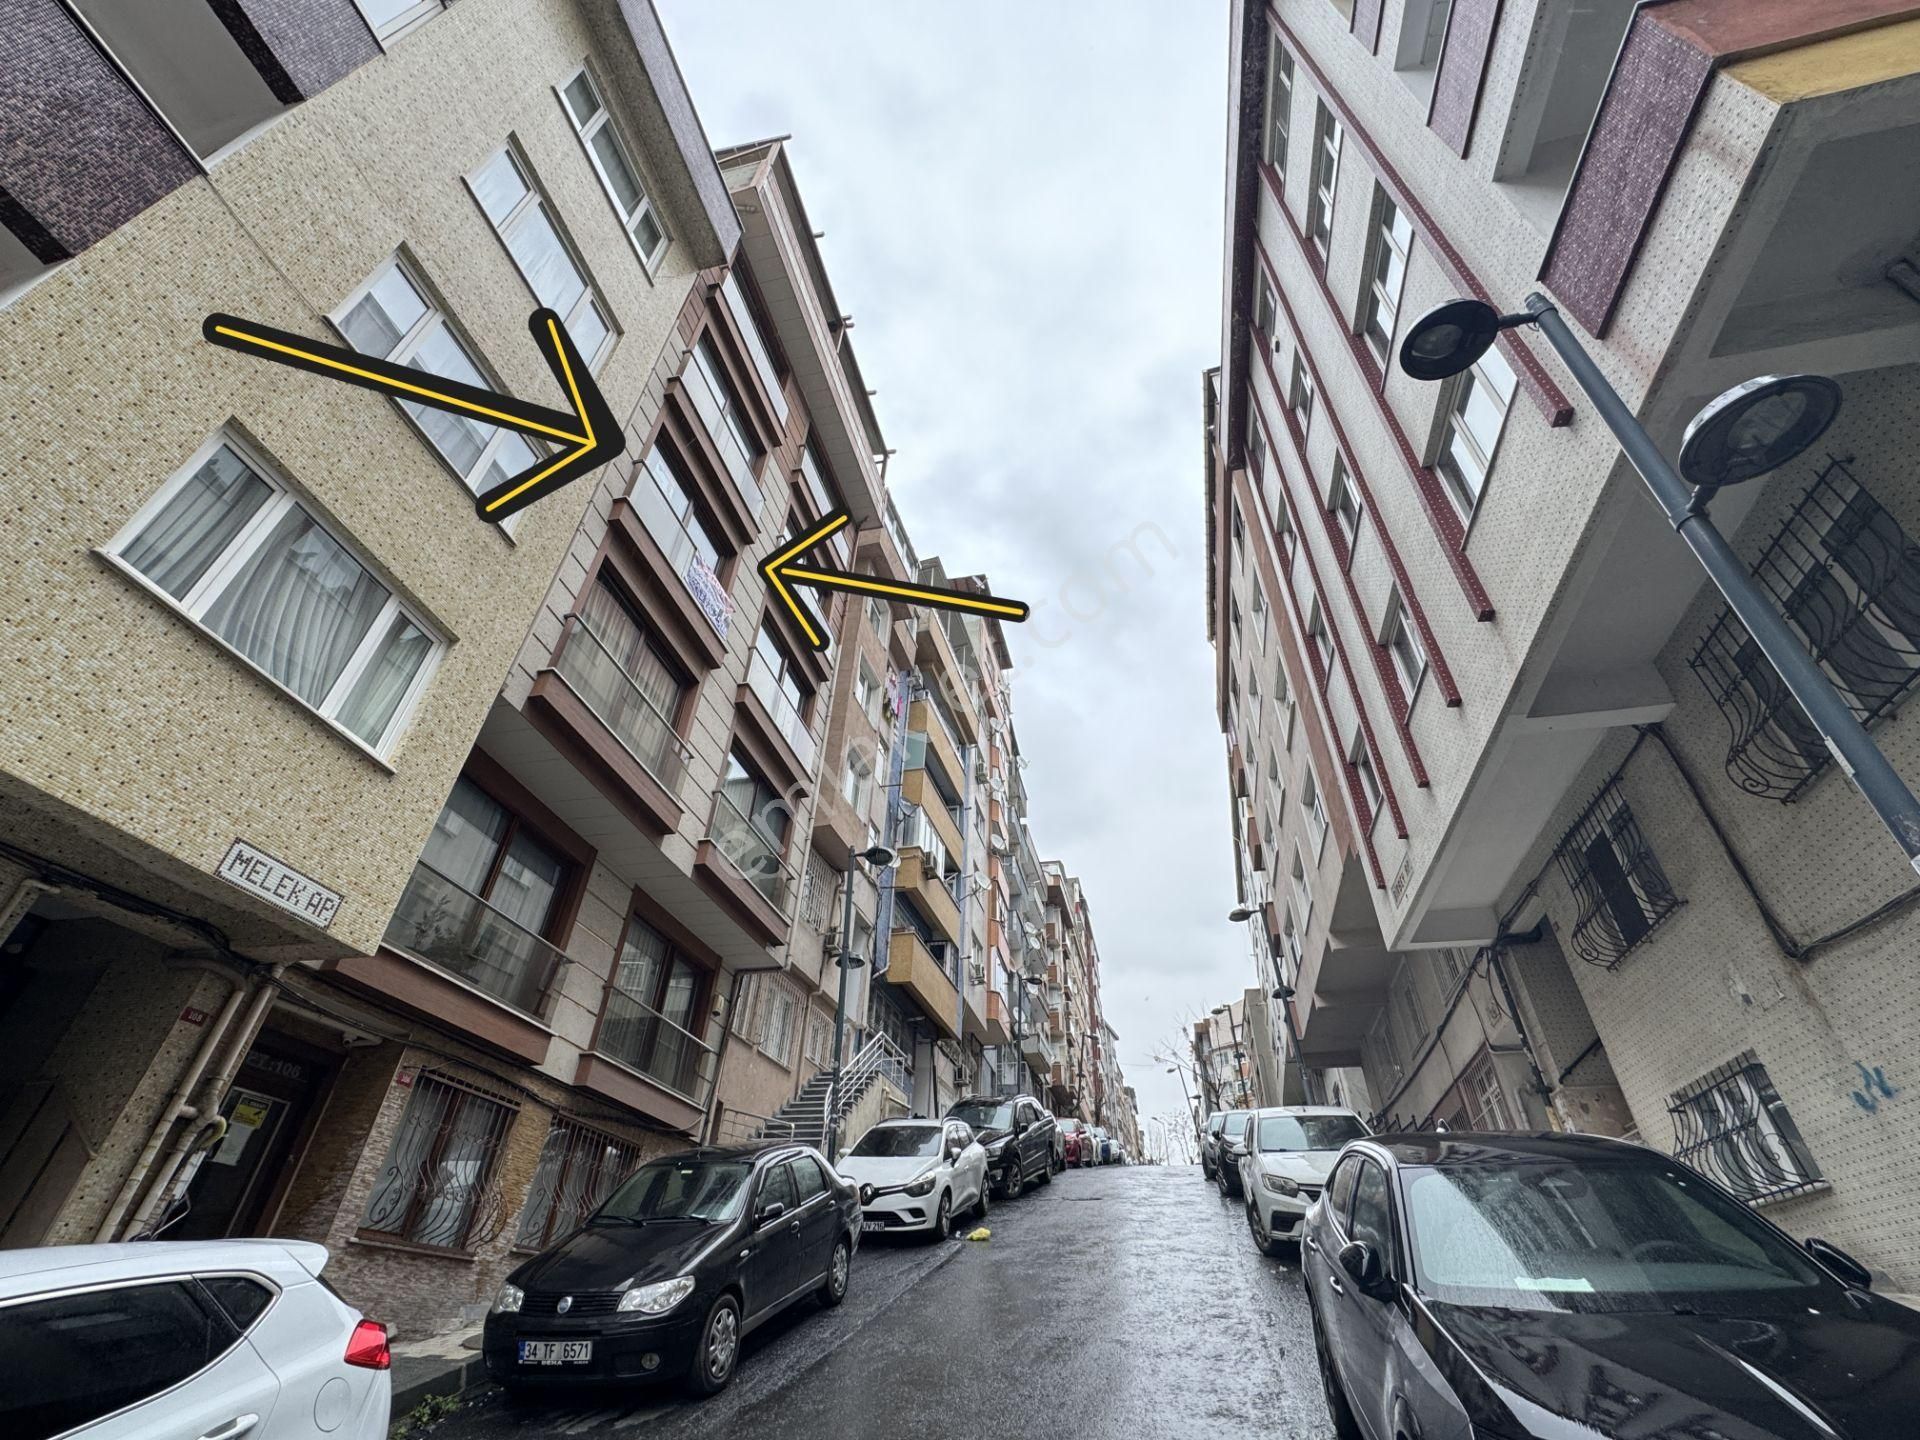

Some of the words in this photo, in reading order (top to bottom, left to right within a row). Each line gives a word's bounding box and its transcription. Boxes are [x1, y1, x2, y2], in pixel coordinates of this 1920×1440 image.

[227, 849, 307, 906] MELEK
[526, 1343, 537, 1358] 34
[544, 1344, 556, 1359] TF
[563, 1343, 589, 1359] 6571
